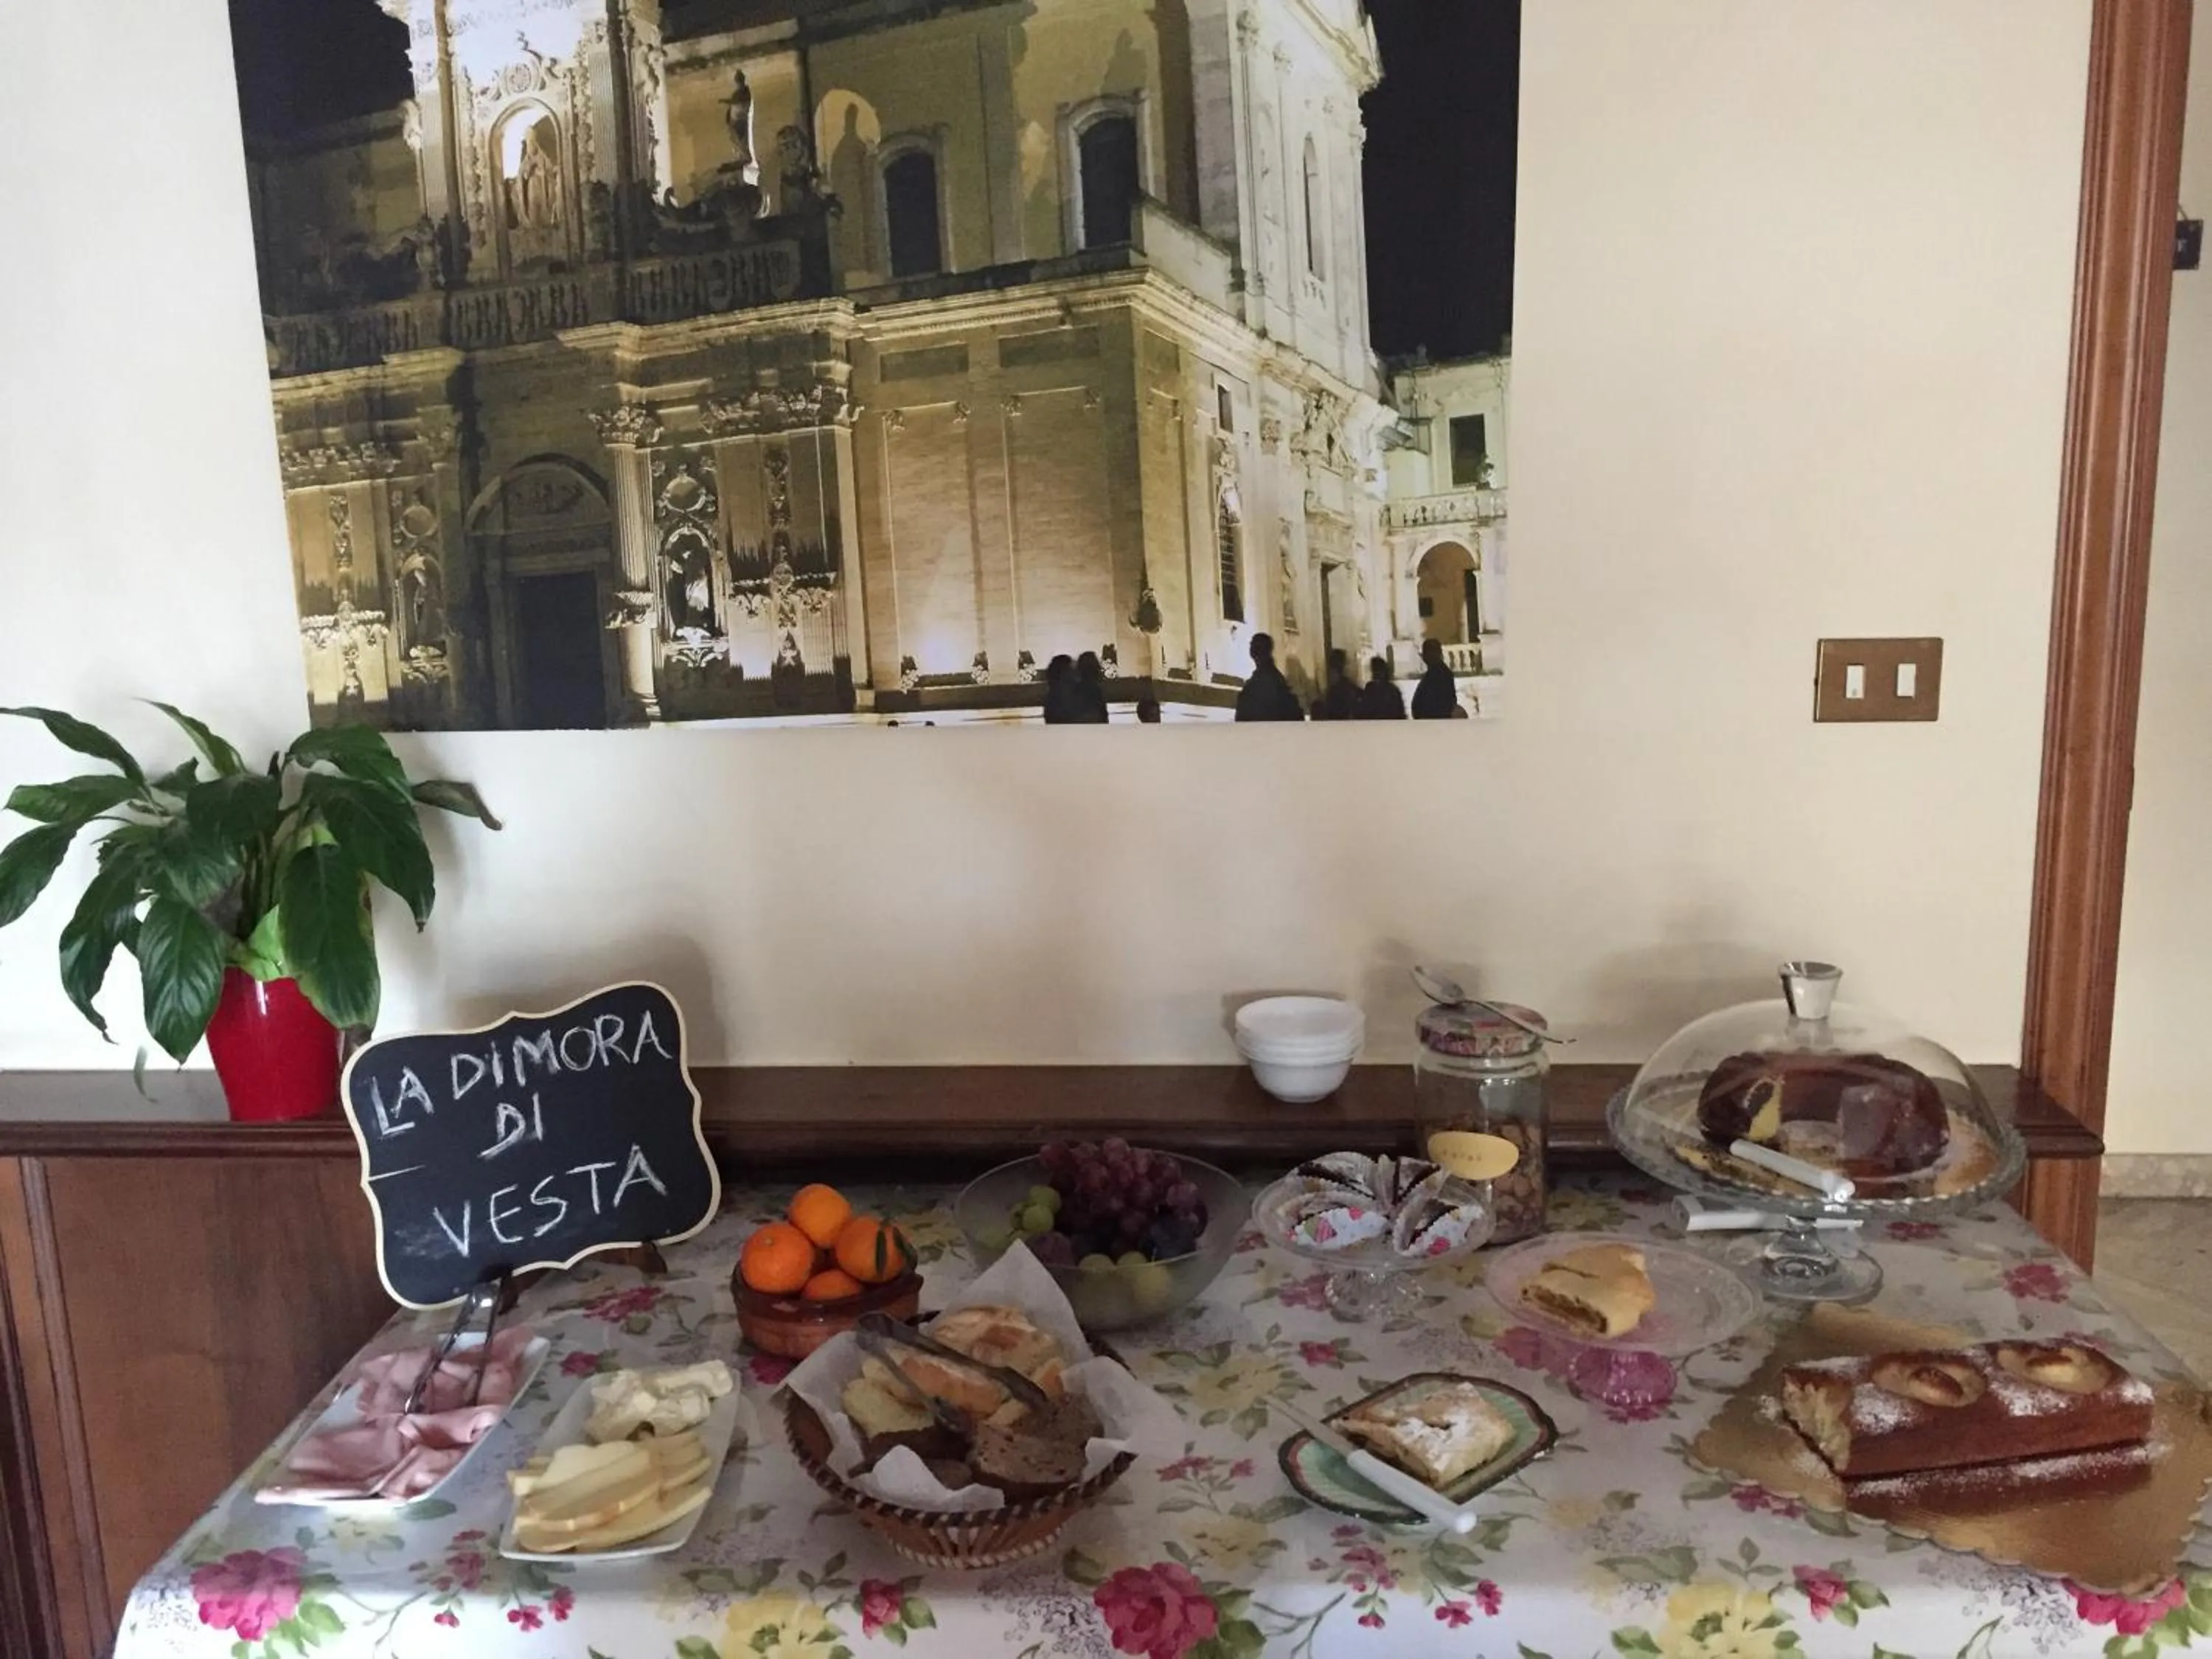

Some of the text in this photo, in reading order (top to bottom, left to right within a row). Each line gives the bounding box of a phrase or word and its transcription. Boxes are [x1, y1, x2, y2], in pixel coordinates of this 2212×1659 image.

[371, 1010, 672, 1139] LA DIMORA
[478, 1092, 543, 1159] DI
[433, 1144, 667, 1257] VESTA
